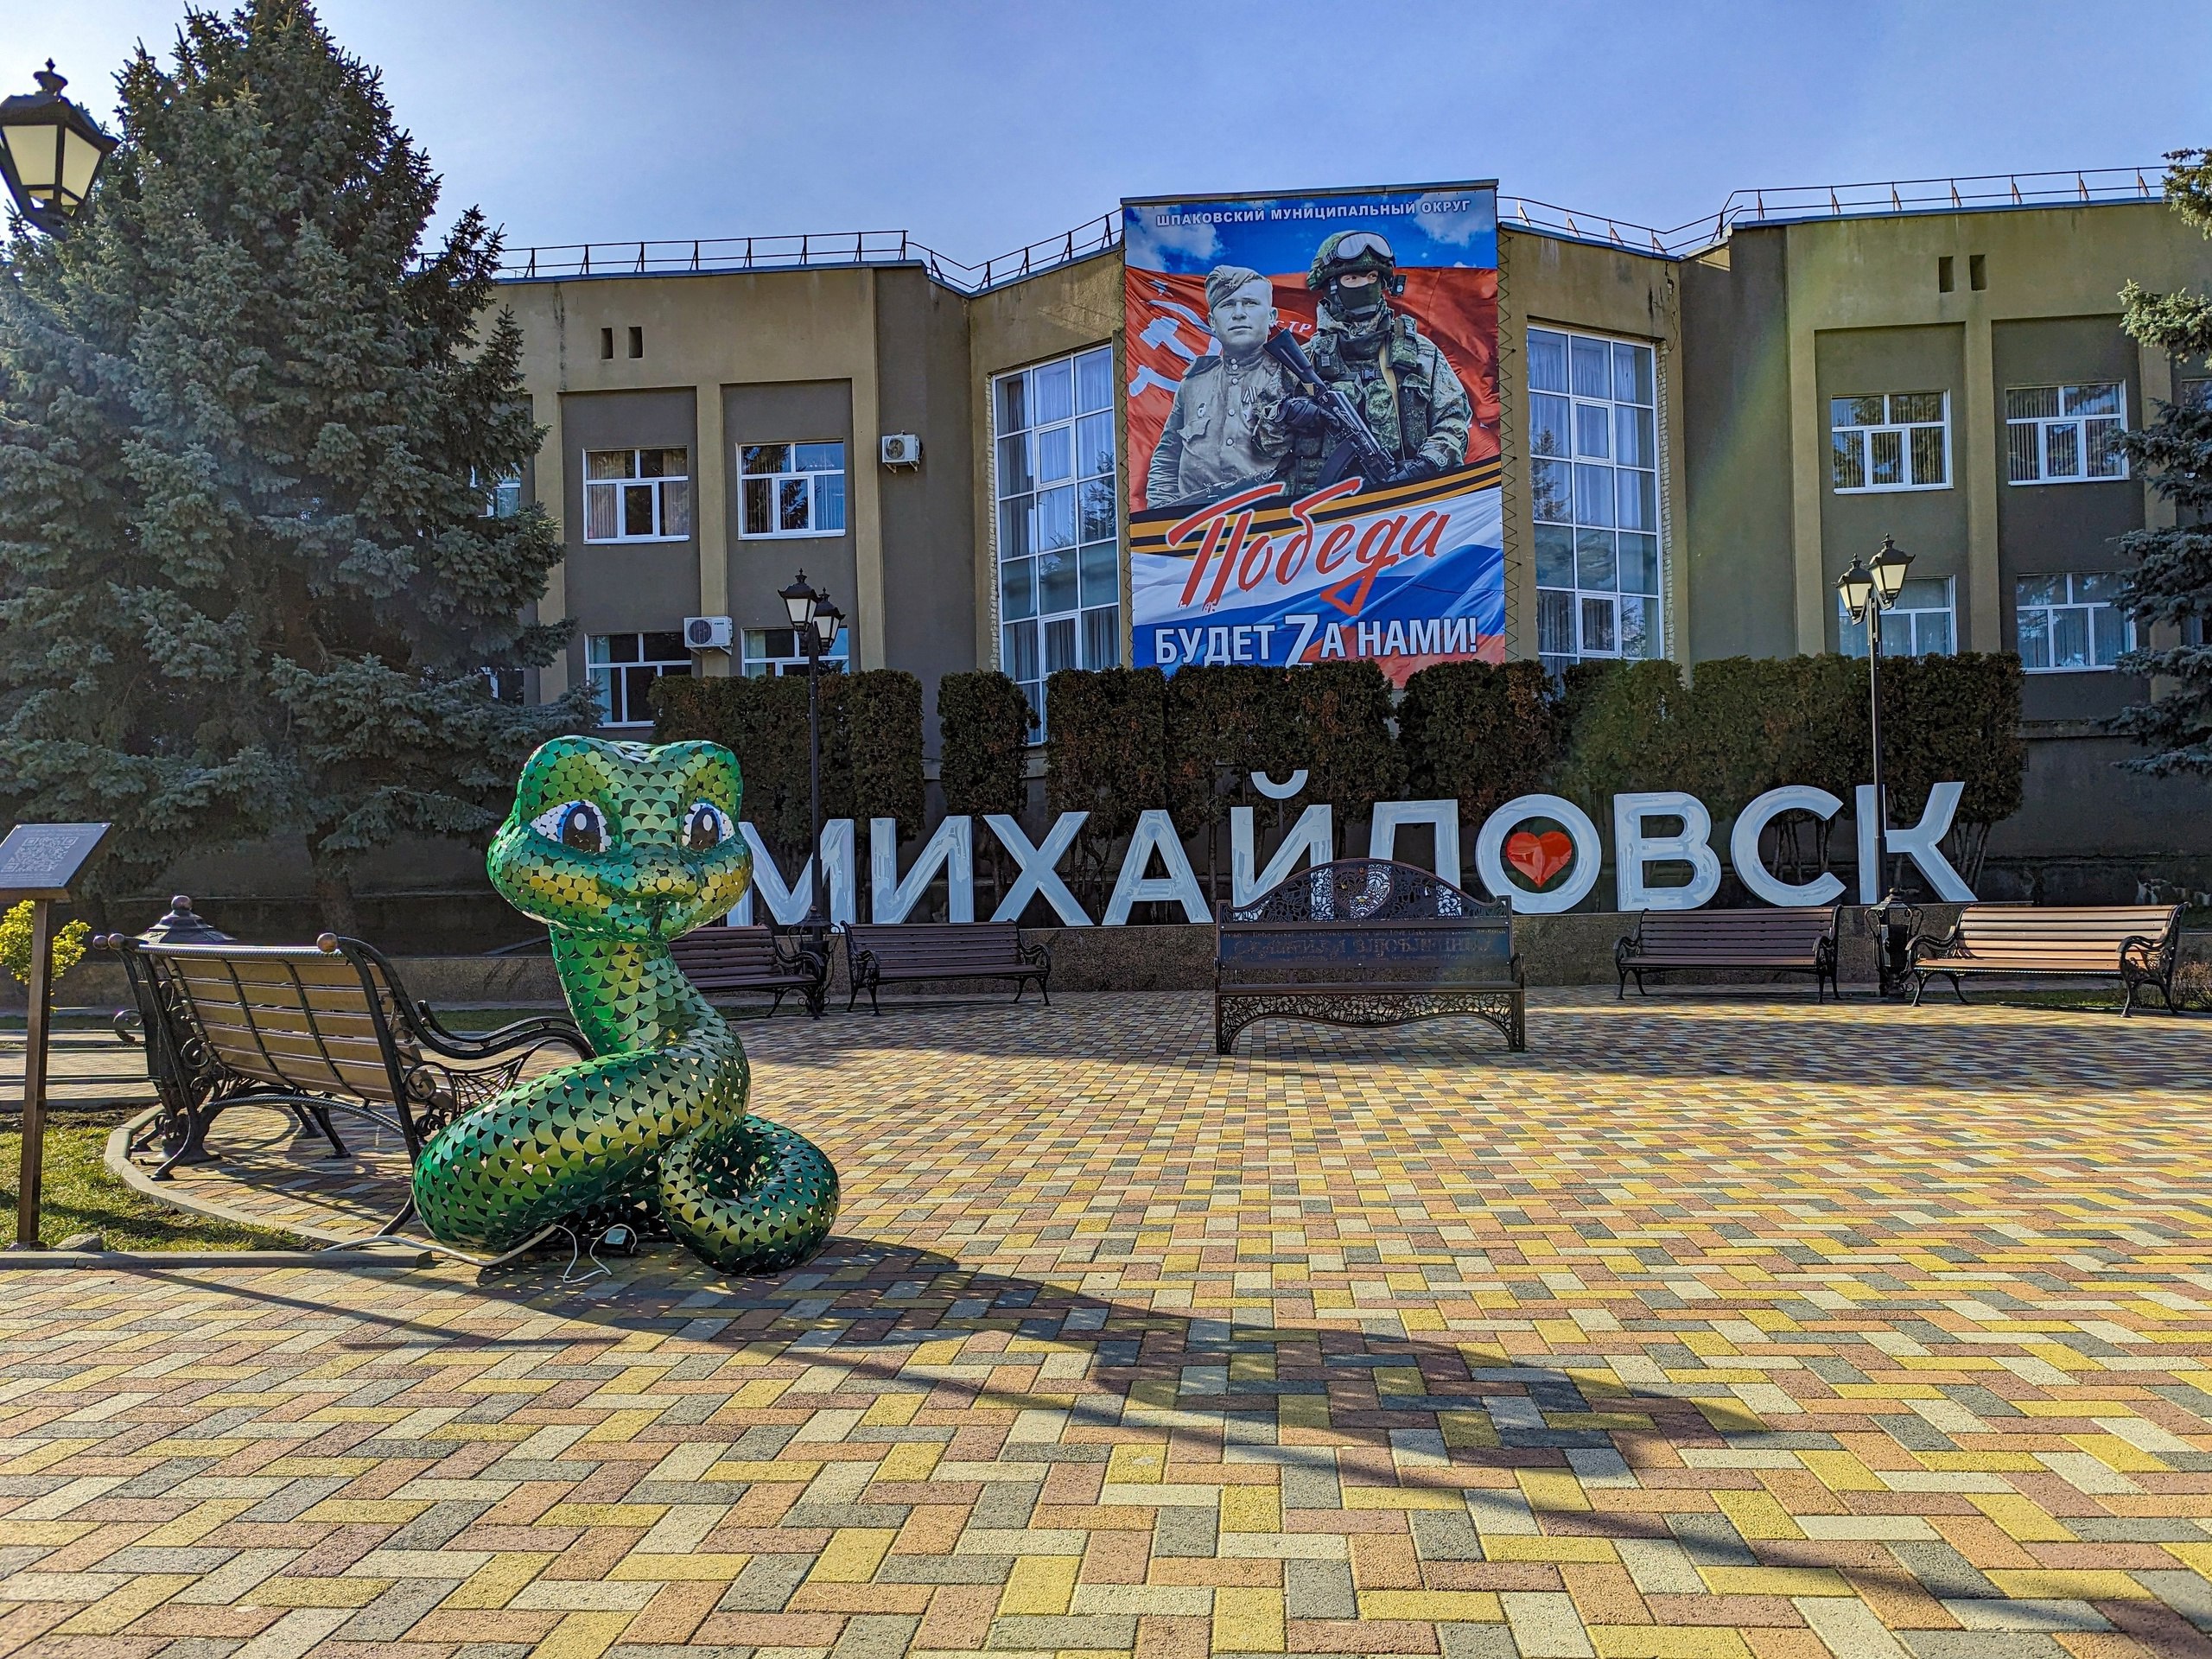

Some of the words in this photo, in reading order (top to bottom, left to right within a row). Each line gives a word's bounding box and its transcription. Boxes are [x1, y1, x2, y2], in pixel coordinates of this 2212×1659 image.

[1157, 208, 1265, 226] ШПАКОВСКИЙ
[1271, 201, 1415, 220] МУНИЦИПАЛЬНЫЙ
[1421, 200, 1470, 213] ОКРУГ
[1166, 477, 1451, 616] Победа
[1155, 625, 1275, 666] БУДЕТ
[1357, 617, 1478, 657] НАМИ!
[728, 769, 1979, 933] МИХАЙЛОВСК
